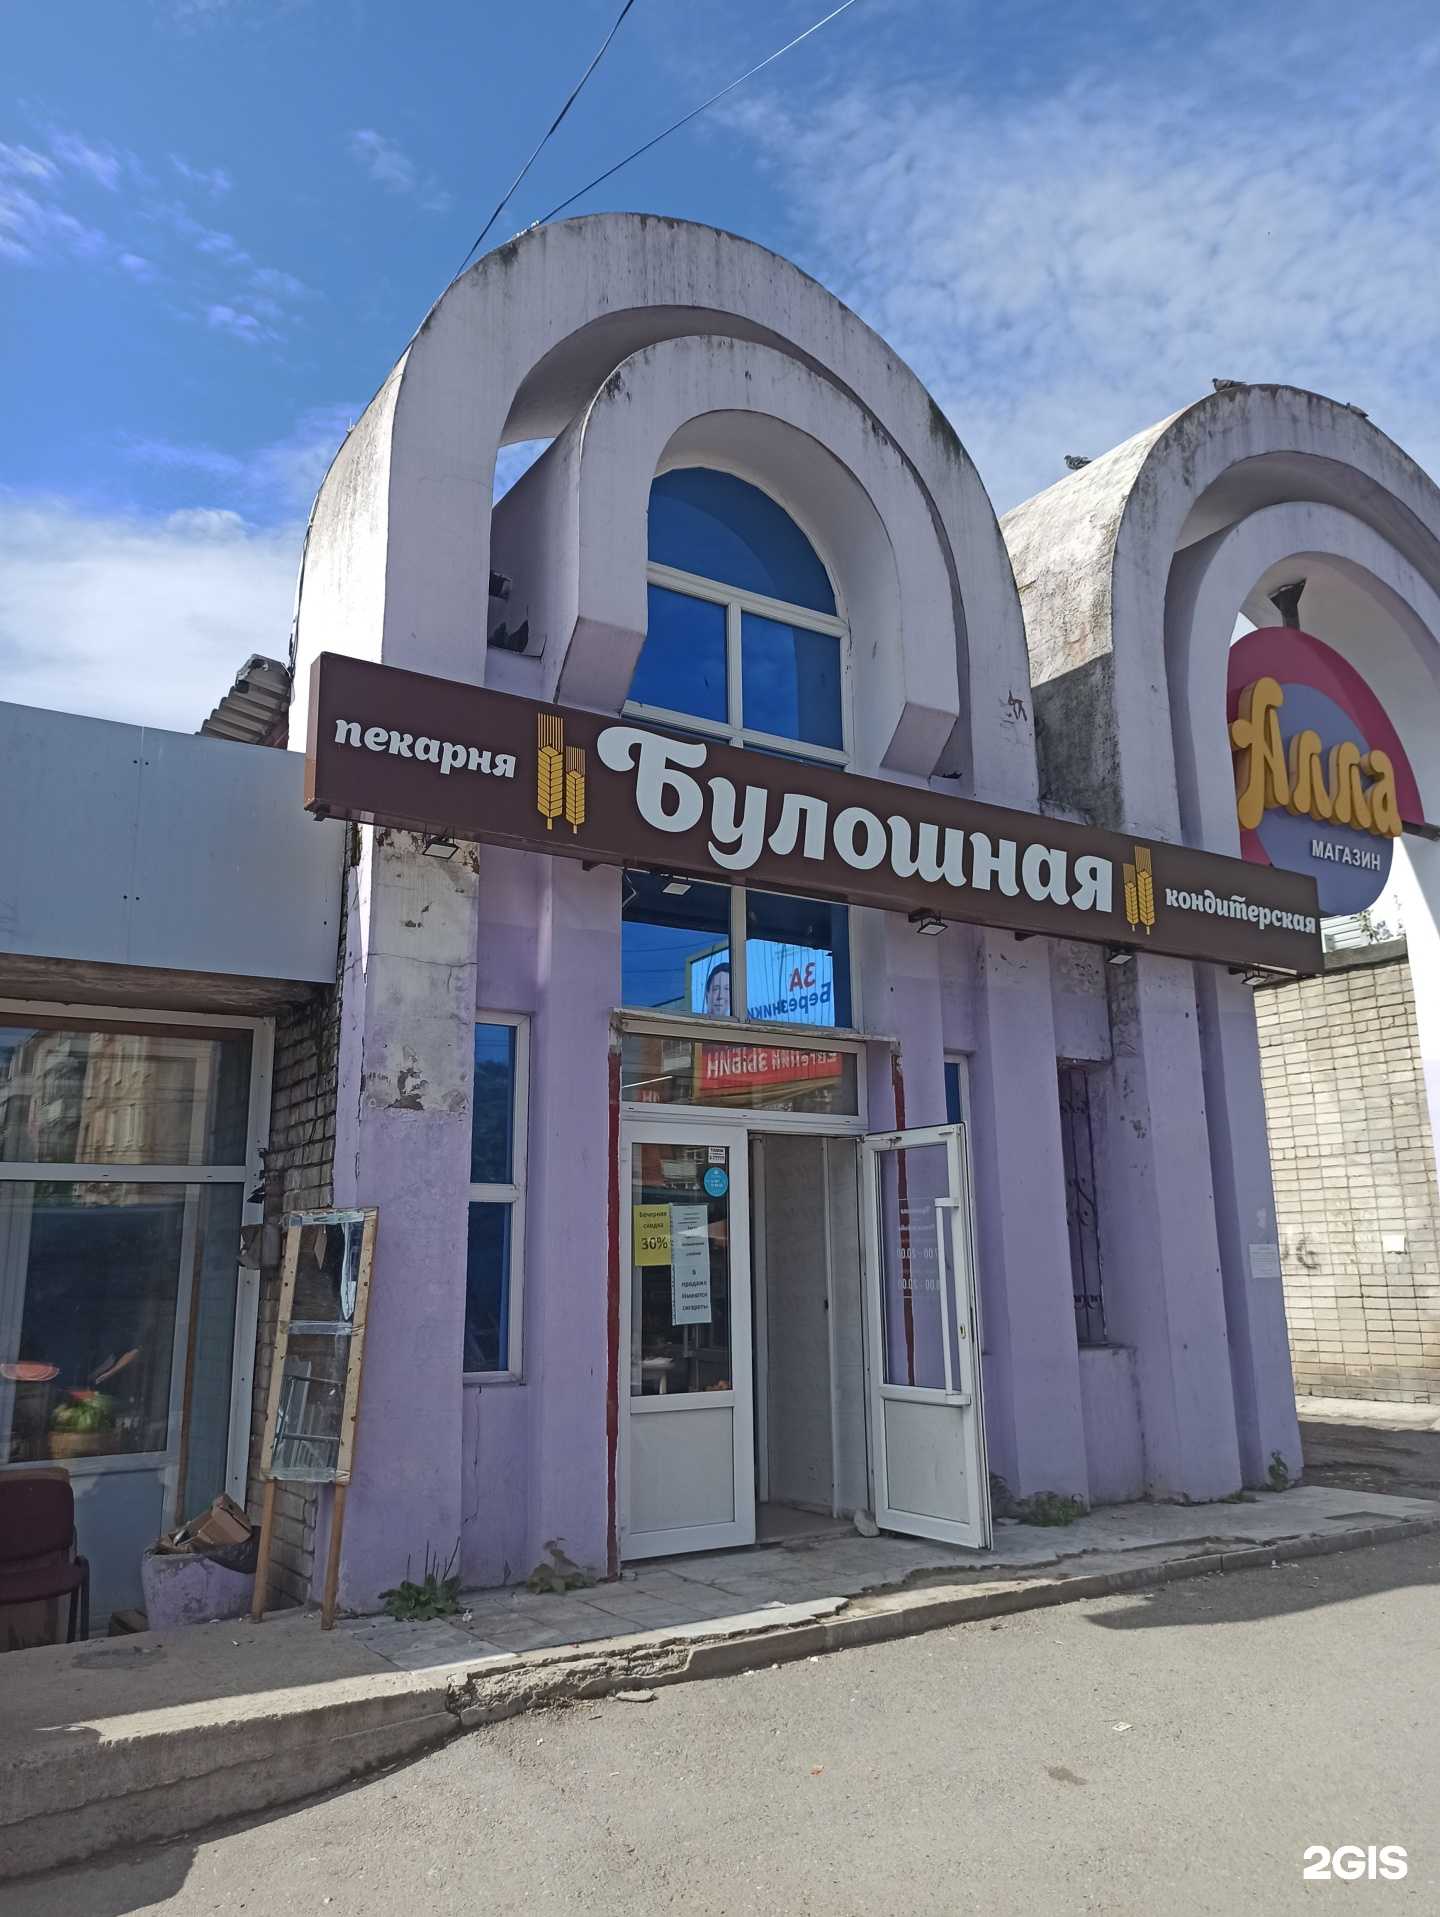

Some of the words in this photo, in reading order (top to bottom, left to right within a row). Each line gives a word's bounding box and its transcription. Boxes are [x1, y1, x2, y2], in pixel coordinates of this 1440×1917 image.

[334, 718, 517, 779] пекарня
[1229, 677, 1402, 837] Алла
[597, 726, 1113, 913] Булошная
[1312, 839, 1381, 871] МАГАЗИН
[1165, 886, 1316, 934] кондитерская
[640, 1236, 668, 1250] 30%
